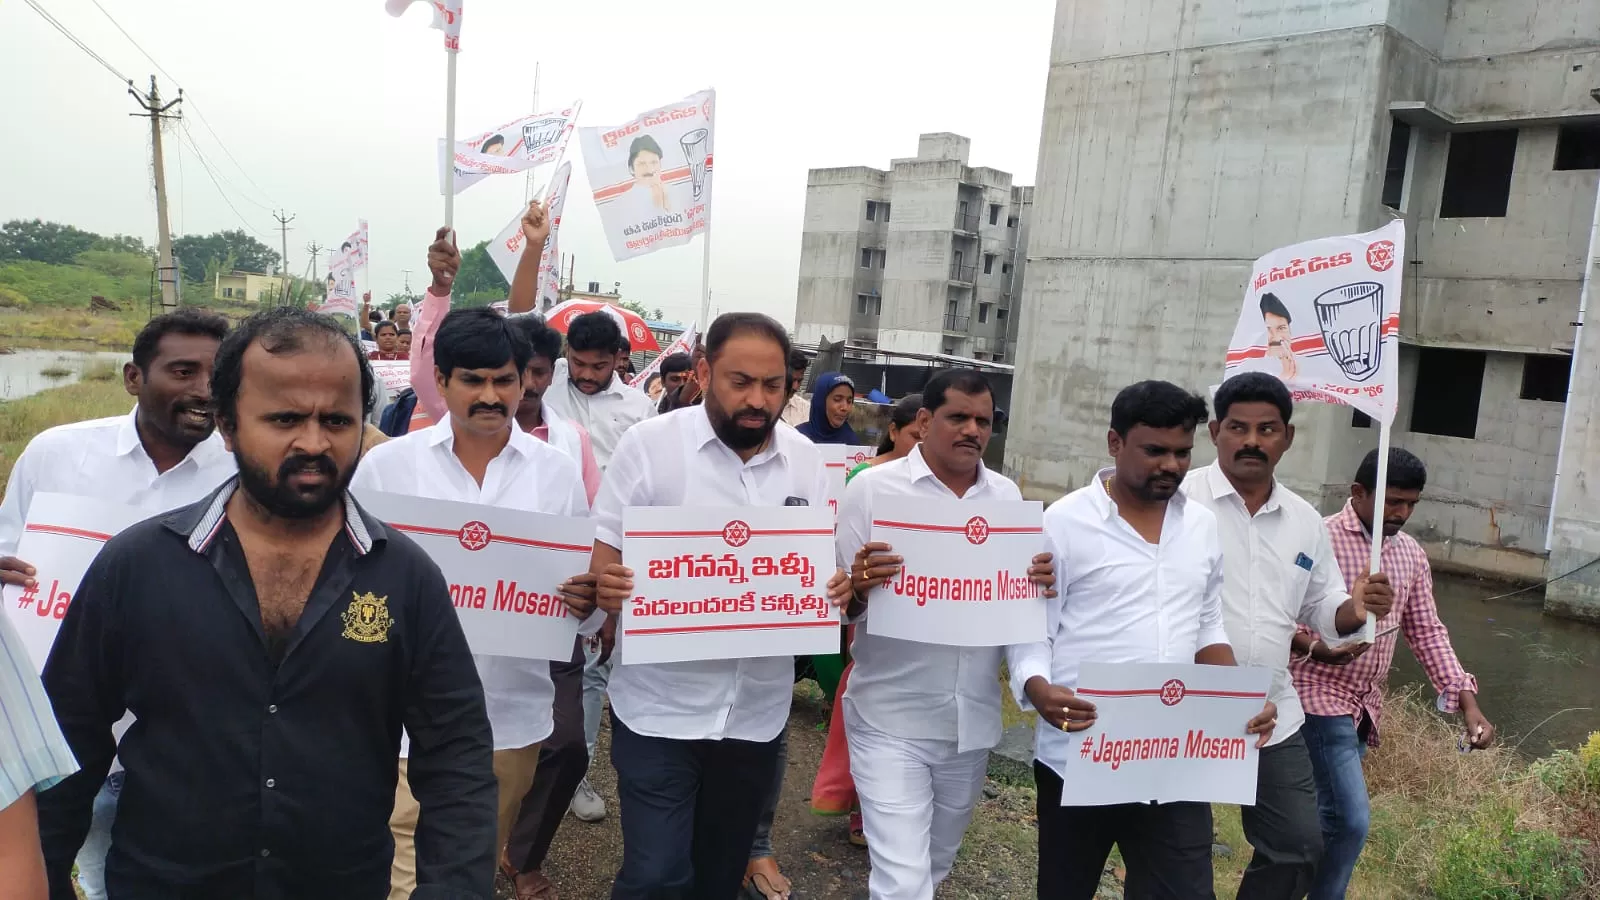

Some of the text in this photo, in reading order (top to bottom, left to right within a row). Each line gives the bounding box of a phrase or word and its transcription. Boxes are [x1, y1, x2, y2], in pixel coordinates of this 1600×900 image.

[648, 553, 748, 584] జగనన్న
[632, 591, 757, 617] పేదలందరికీ
[1080, 729, 1246, 770] #Jagananna Mosam
